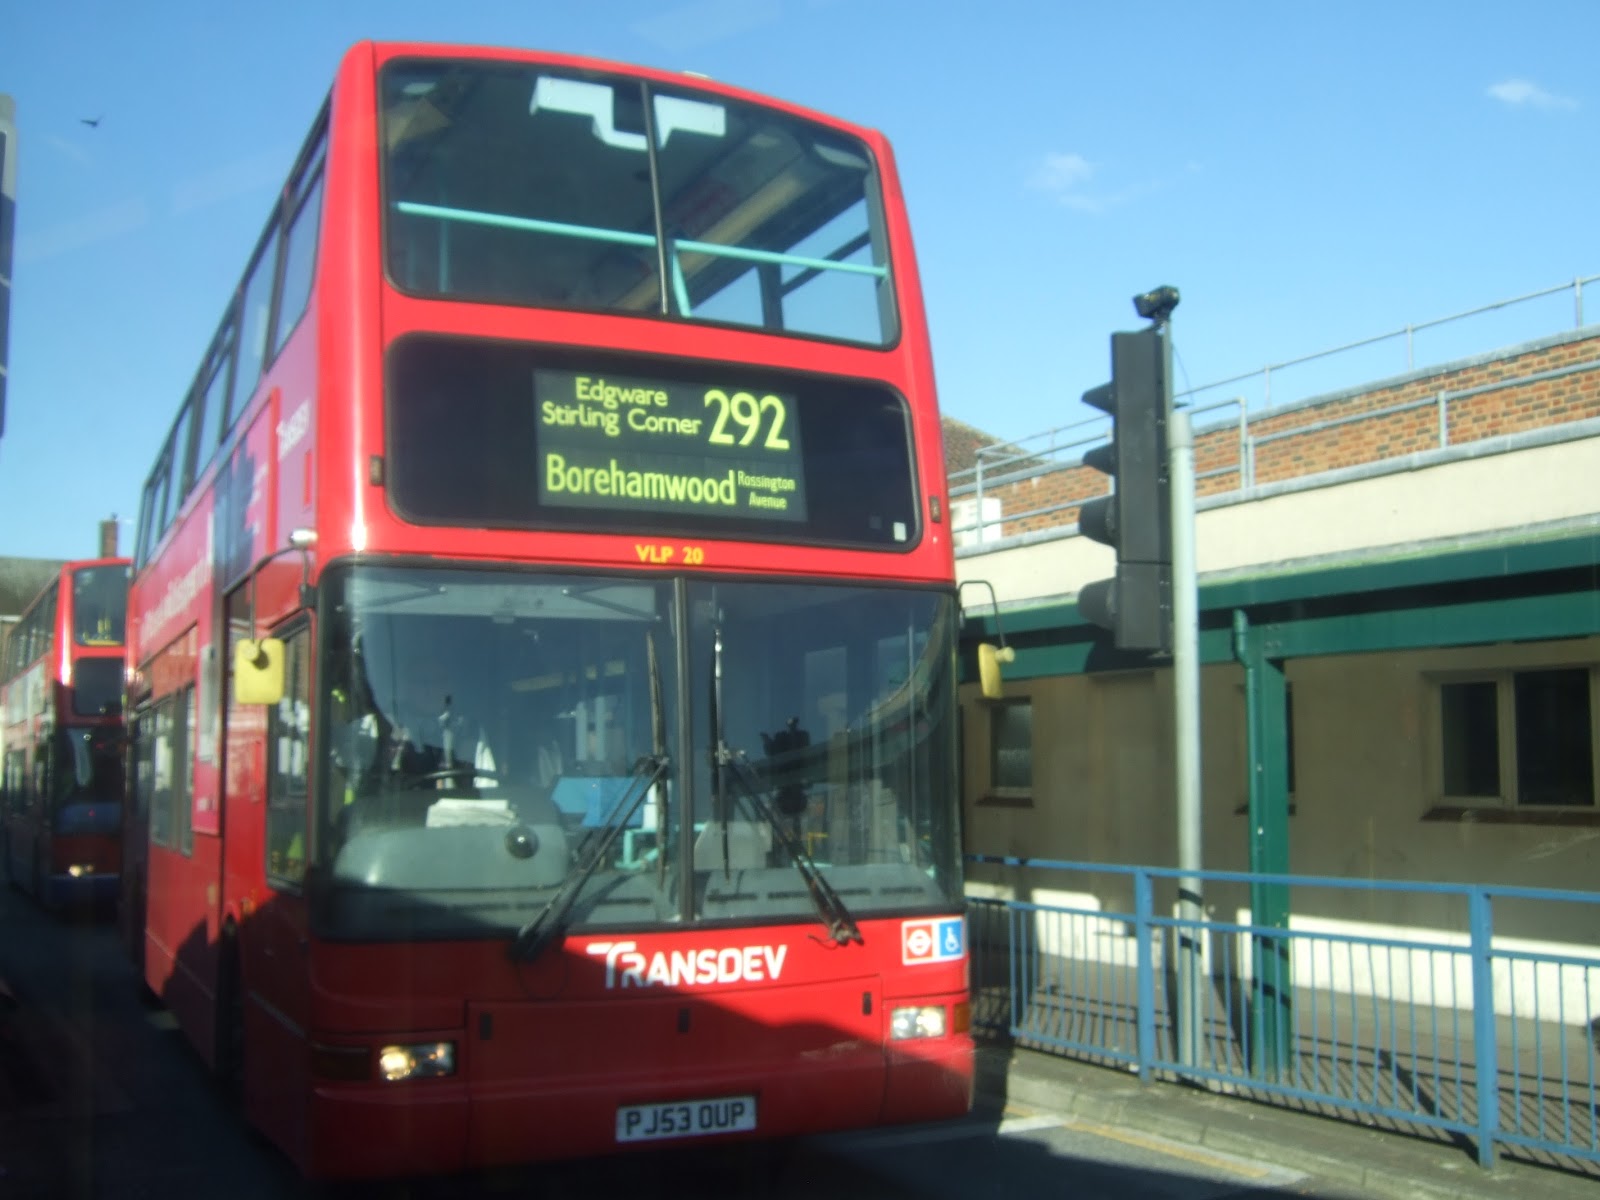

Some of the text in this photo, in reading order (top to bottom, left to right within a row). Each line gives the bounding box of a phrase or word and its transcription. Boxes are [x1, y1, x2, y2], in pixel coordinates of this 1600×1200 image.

[576, 376, 668, 409] Edgware
[542, 400, 702, 437] Stirling Corner
[704, 389, 790, 450] 292
[546, 453, 736, 505] Borehamwood
[738, 471, 795, 493] Rossington
[749, 492, 787, 510] Avenue
[635, 544, 703, 564] VLP 20
[625, 1106, 691, 1137] PJ53
